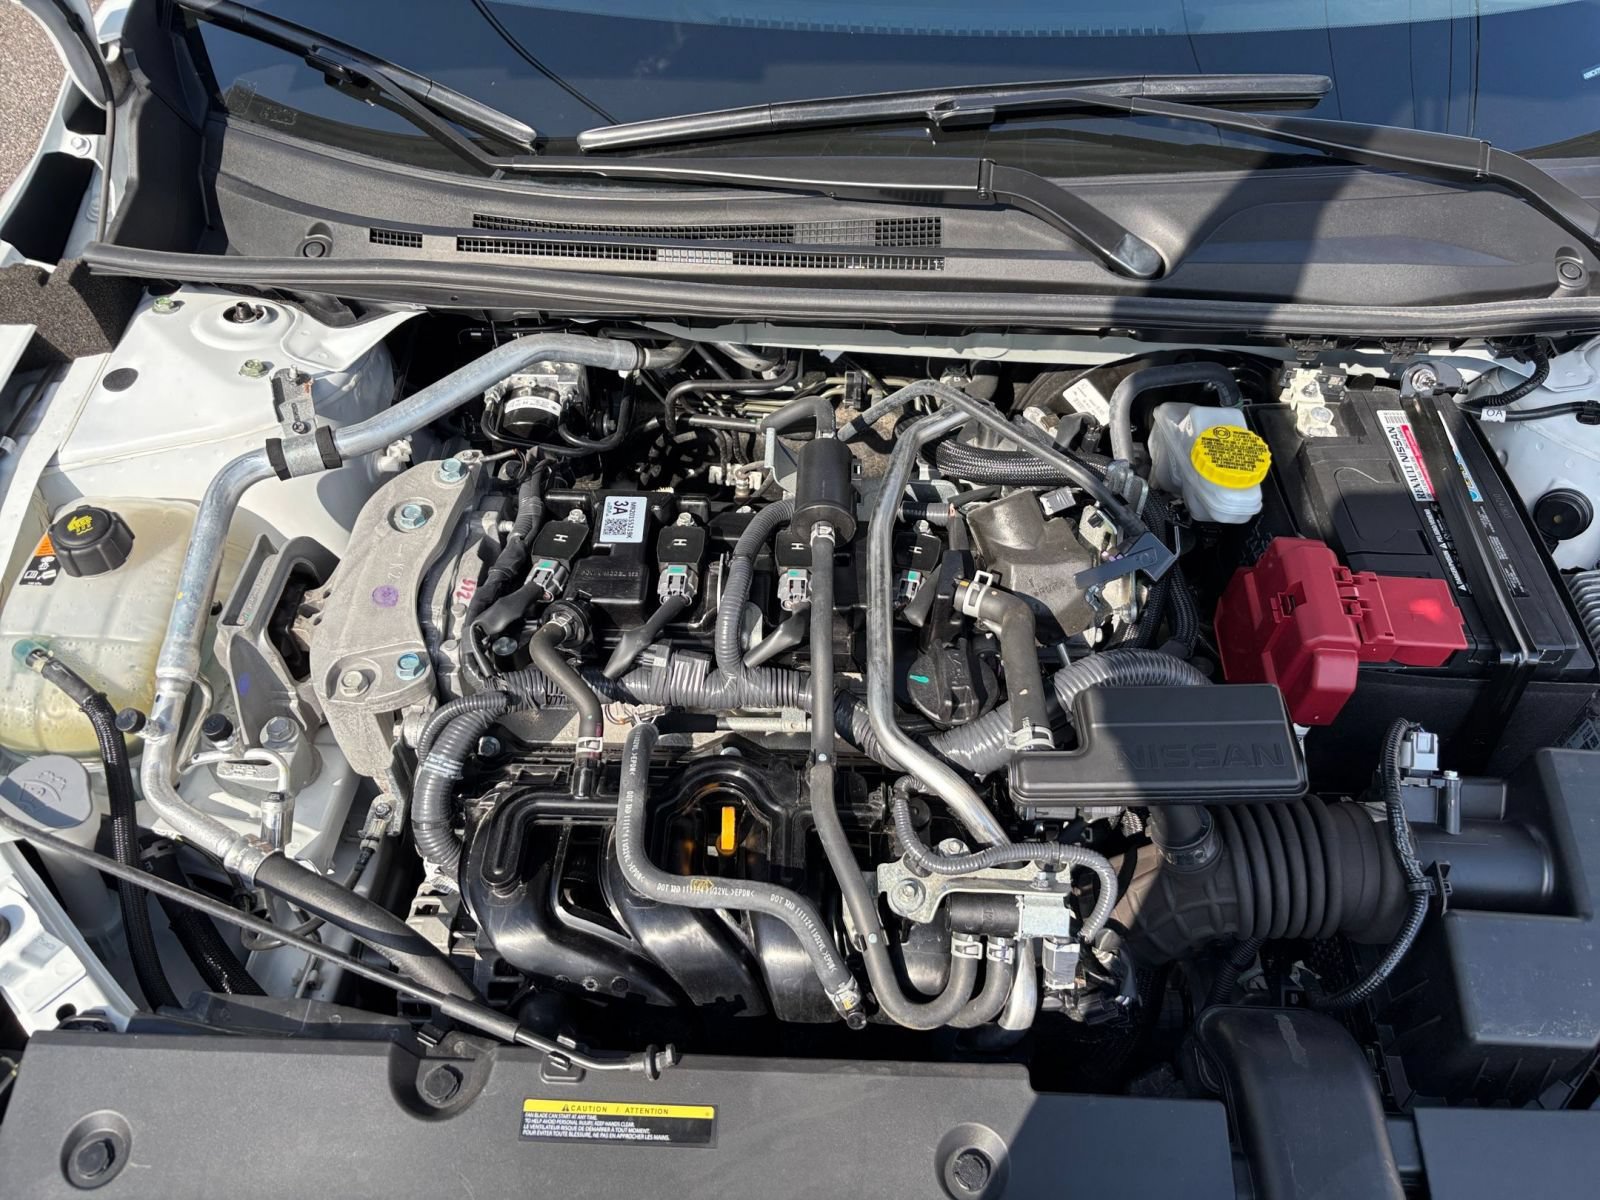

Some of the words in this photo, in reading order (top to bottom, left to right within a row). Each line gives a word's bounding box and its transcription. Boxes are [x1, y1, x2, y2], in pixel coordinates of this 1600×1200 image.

[1385, 426, 1409, 463] NISSAN
[612, 500, 629, 515] 3A
[1115, 742, 1287, 770] NISSAN
[570, 1104, 608, 1113] CAUTION
[624, 1106, 669, 1115] ATTENTION
